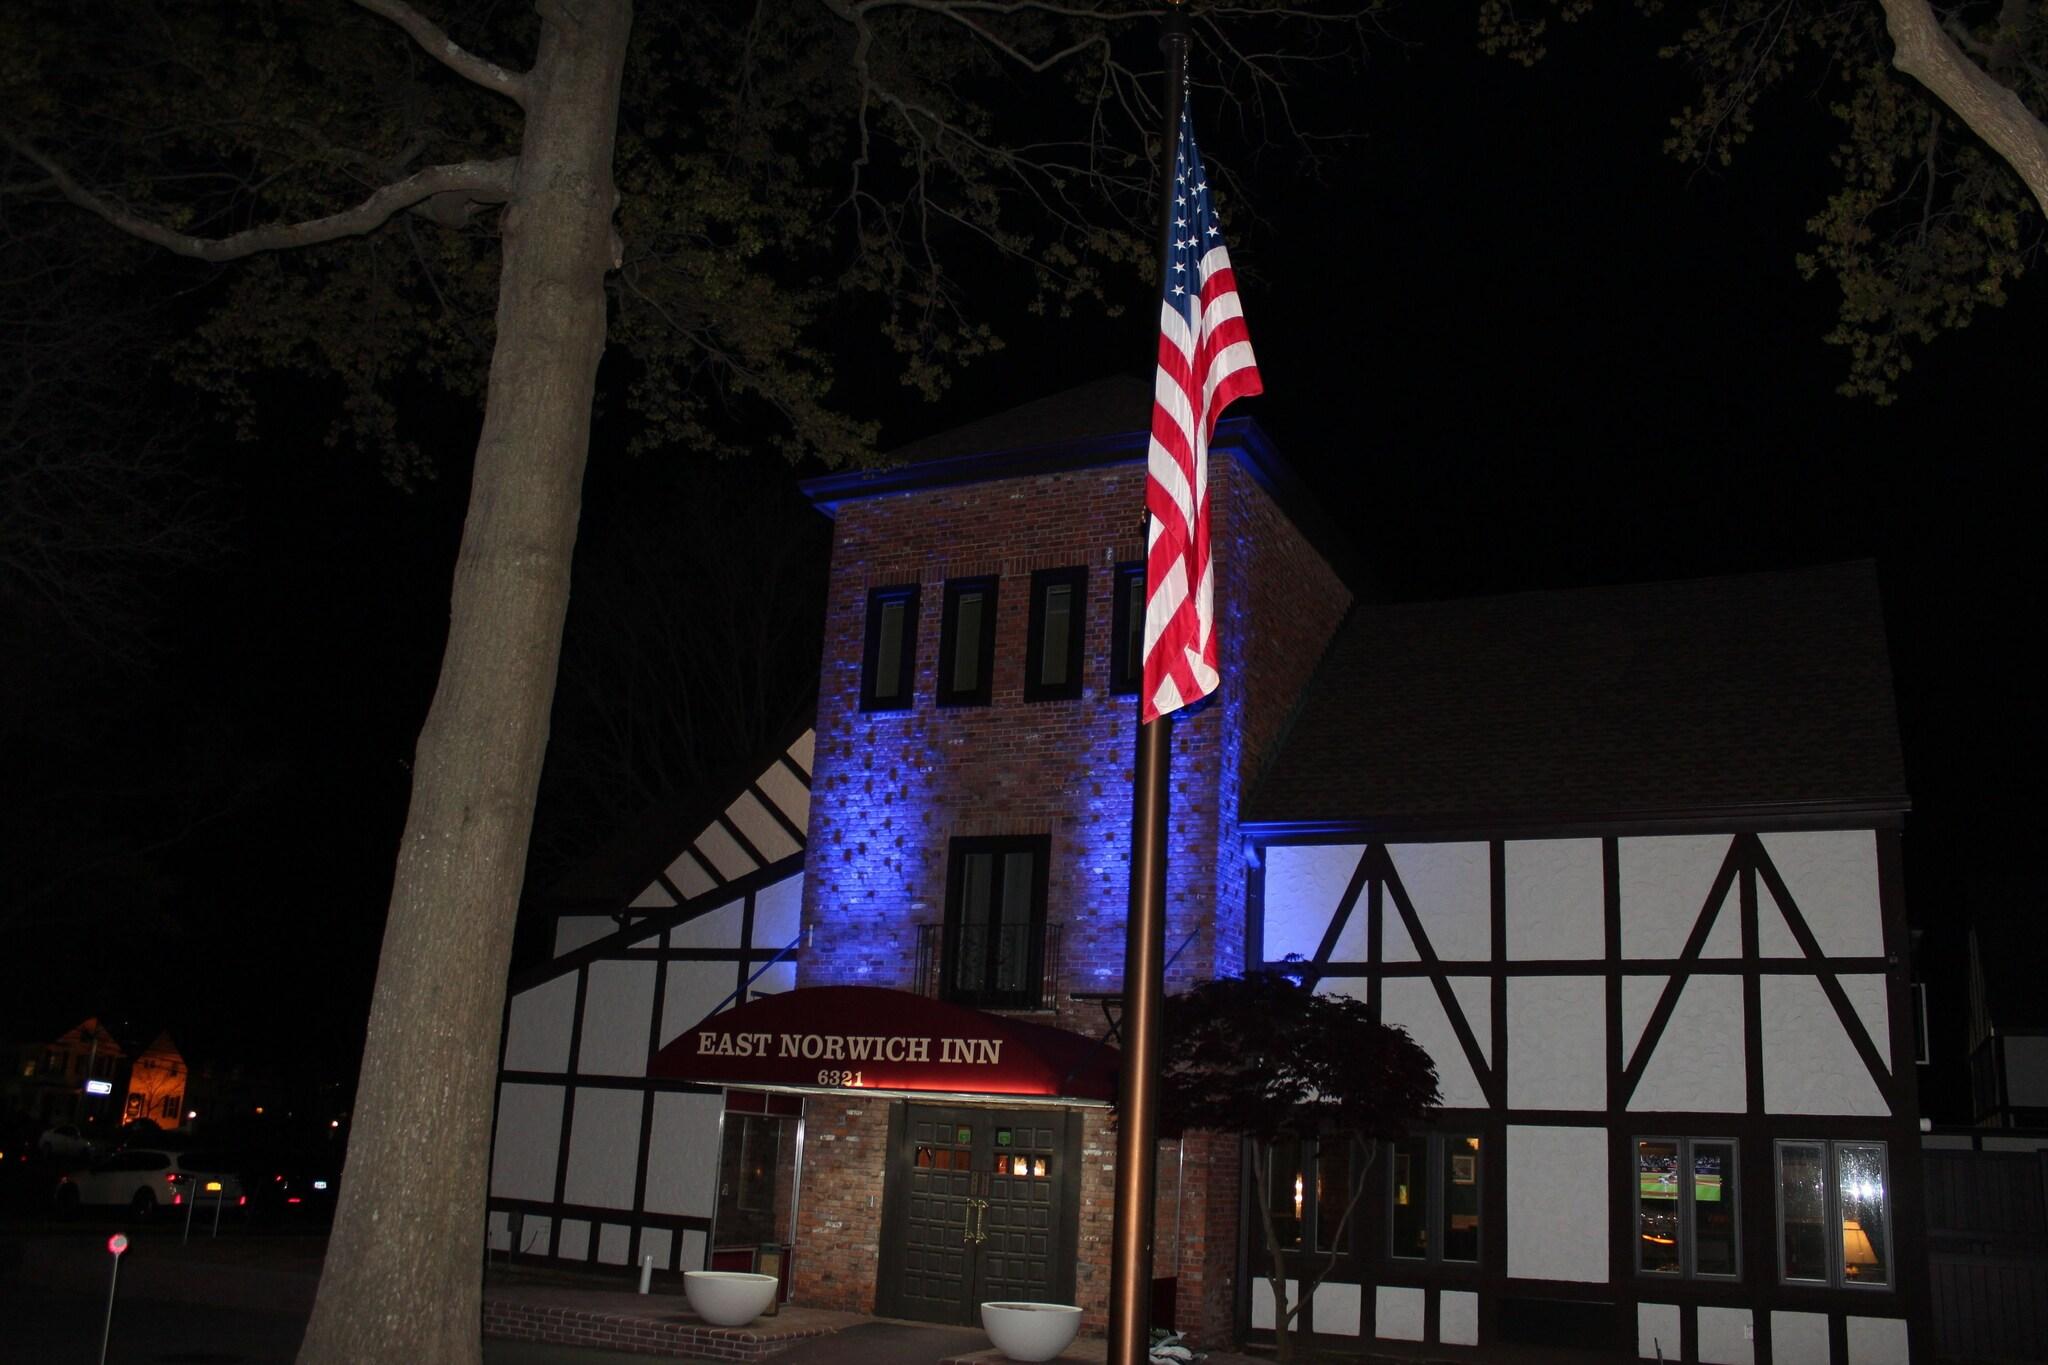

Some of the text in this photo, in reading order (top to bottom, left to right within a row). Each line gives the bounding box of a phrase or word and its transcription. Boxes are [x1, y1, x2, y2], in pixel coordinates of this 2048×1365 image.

[697, 1032, 1003, 1064] EAST NORWICH INN
[817, 1069, 864, 1088] 6321
